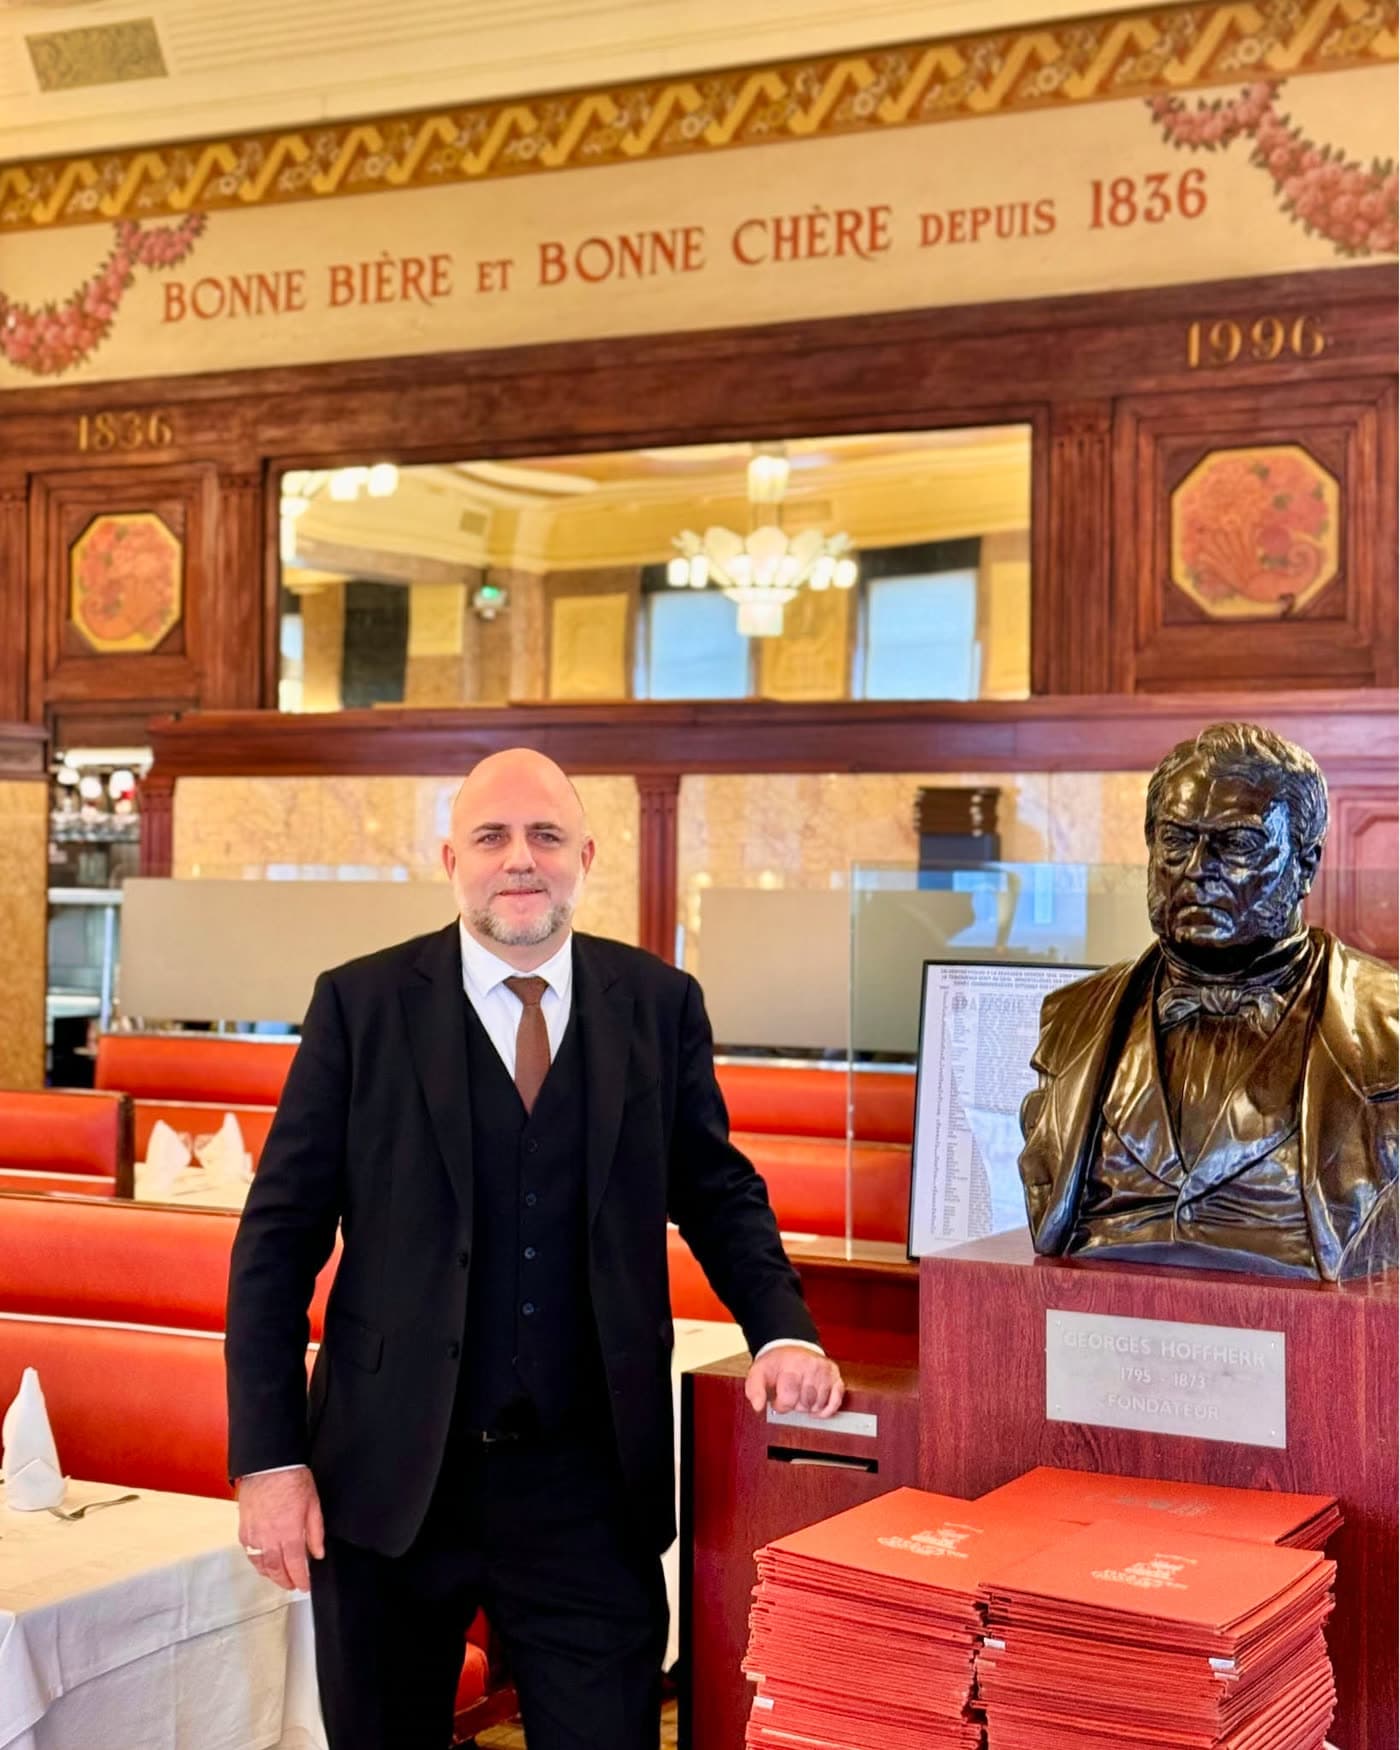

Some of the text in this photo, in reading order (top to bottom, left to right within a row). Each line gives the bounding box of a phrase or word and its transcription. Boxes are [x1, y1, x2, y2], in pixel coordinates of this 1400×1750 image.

[164, 167, 1208, 323] BONNE BIÈRE ET BONNE CHÈRE DEPUIS 1836
[1187, 314, 1326, 369] 1996
[78, 412, 173, 452] 1836
[1063, 1330, 1265, 1368] GEORGES HOFFHERR
[1120, 1367, 1151, 1384] 1795
[1105, 1394, 1220, 1421] FONDATEUR
